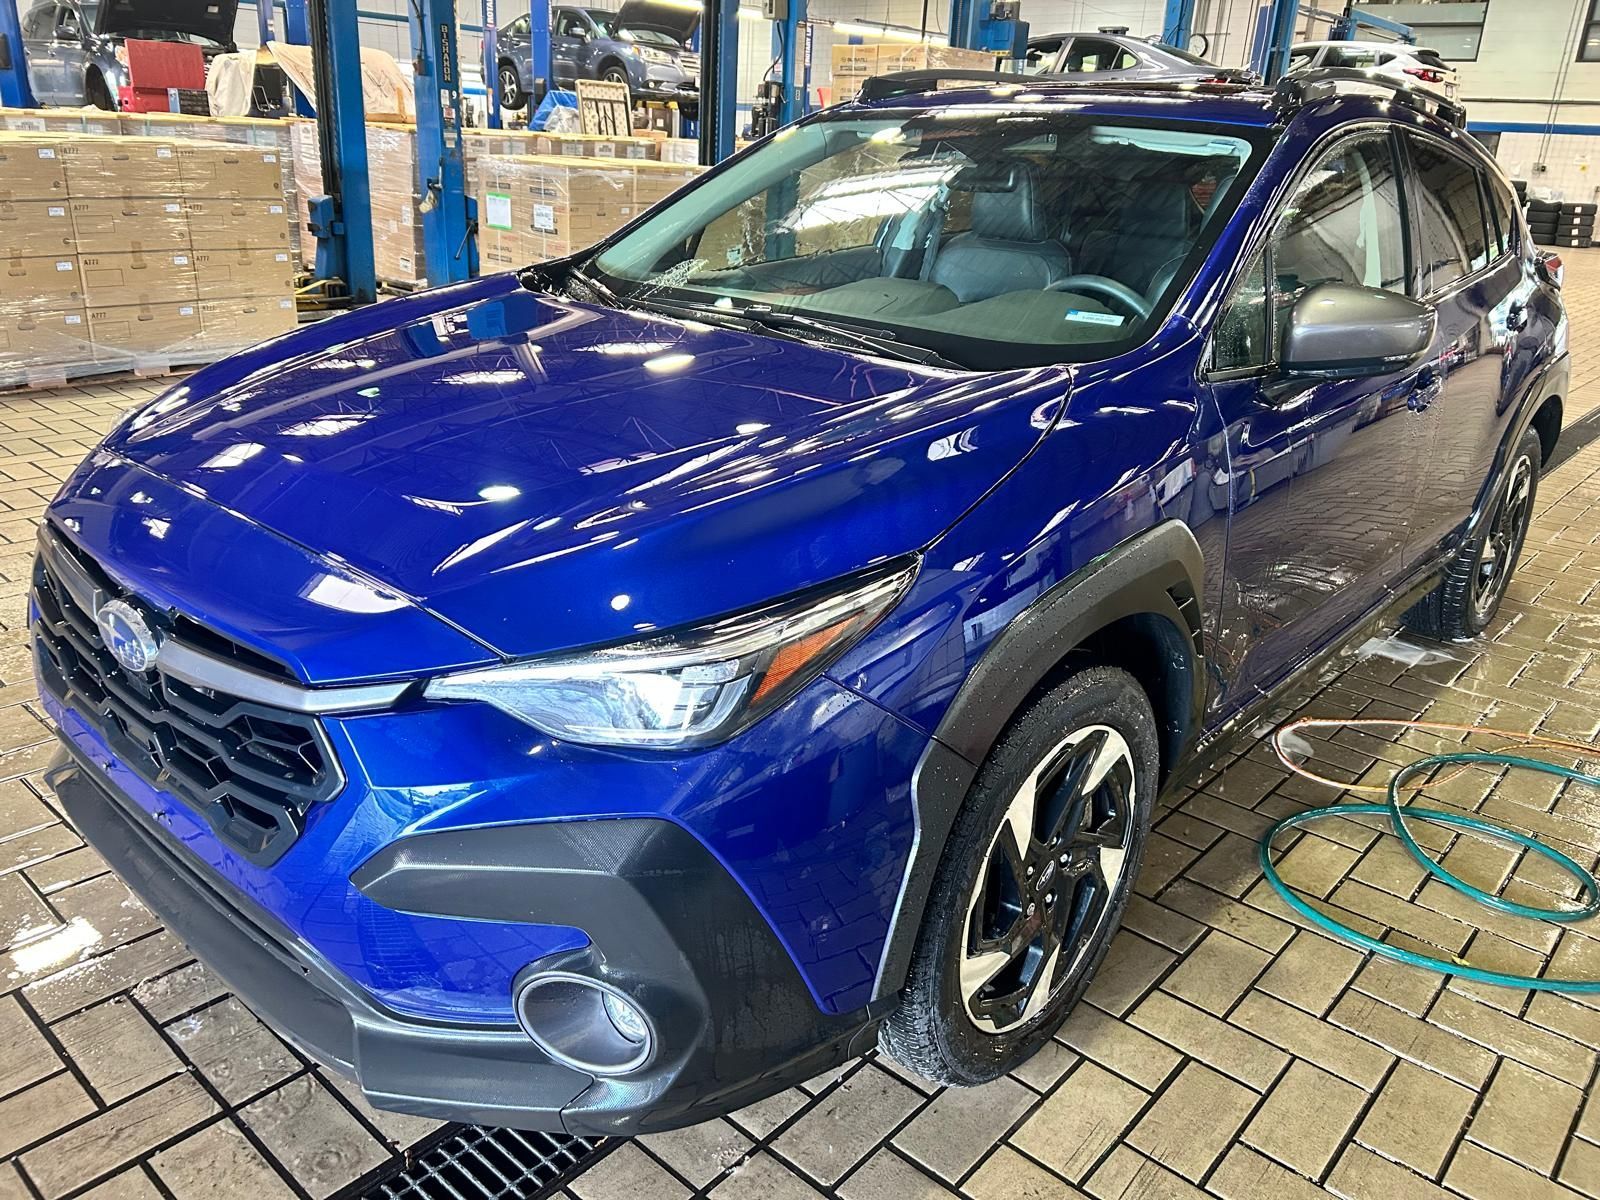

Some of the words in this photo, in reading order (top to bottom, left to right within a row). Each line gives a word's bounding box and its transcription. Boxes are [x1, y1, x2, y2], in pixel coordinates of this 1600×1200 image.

[486, 0, 494, 24] ROTA
[441, 25, 451, 81] BISHAMON
[451, 90, 457, 99] 9
